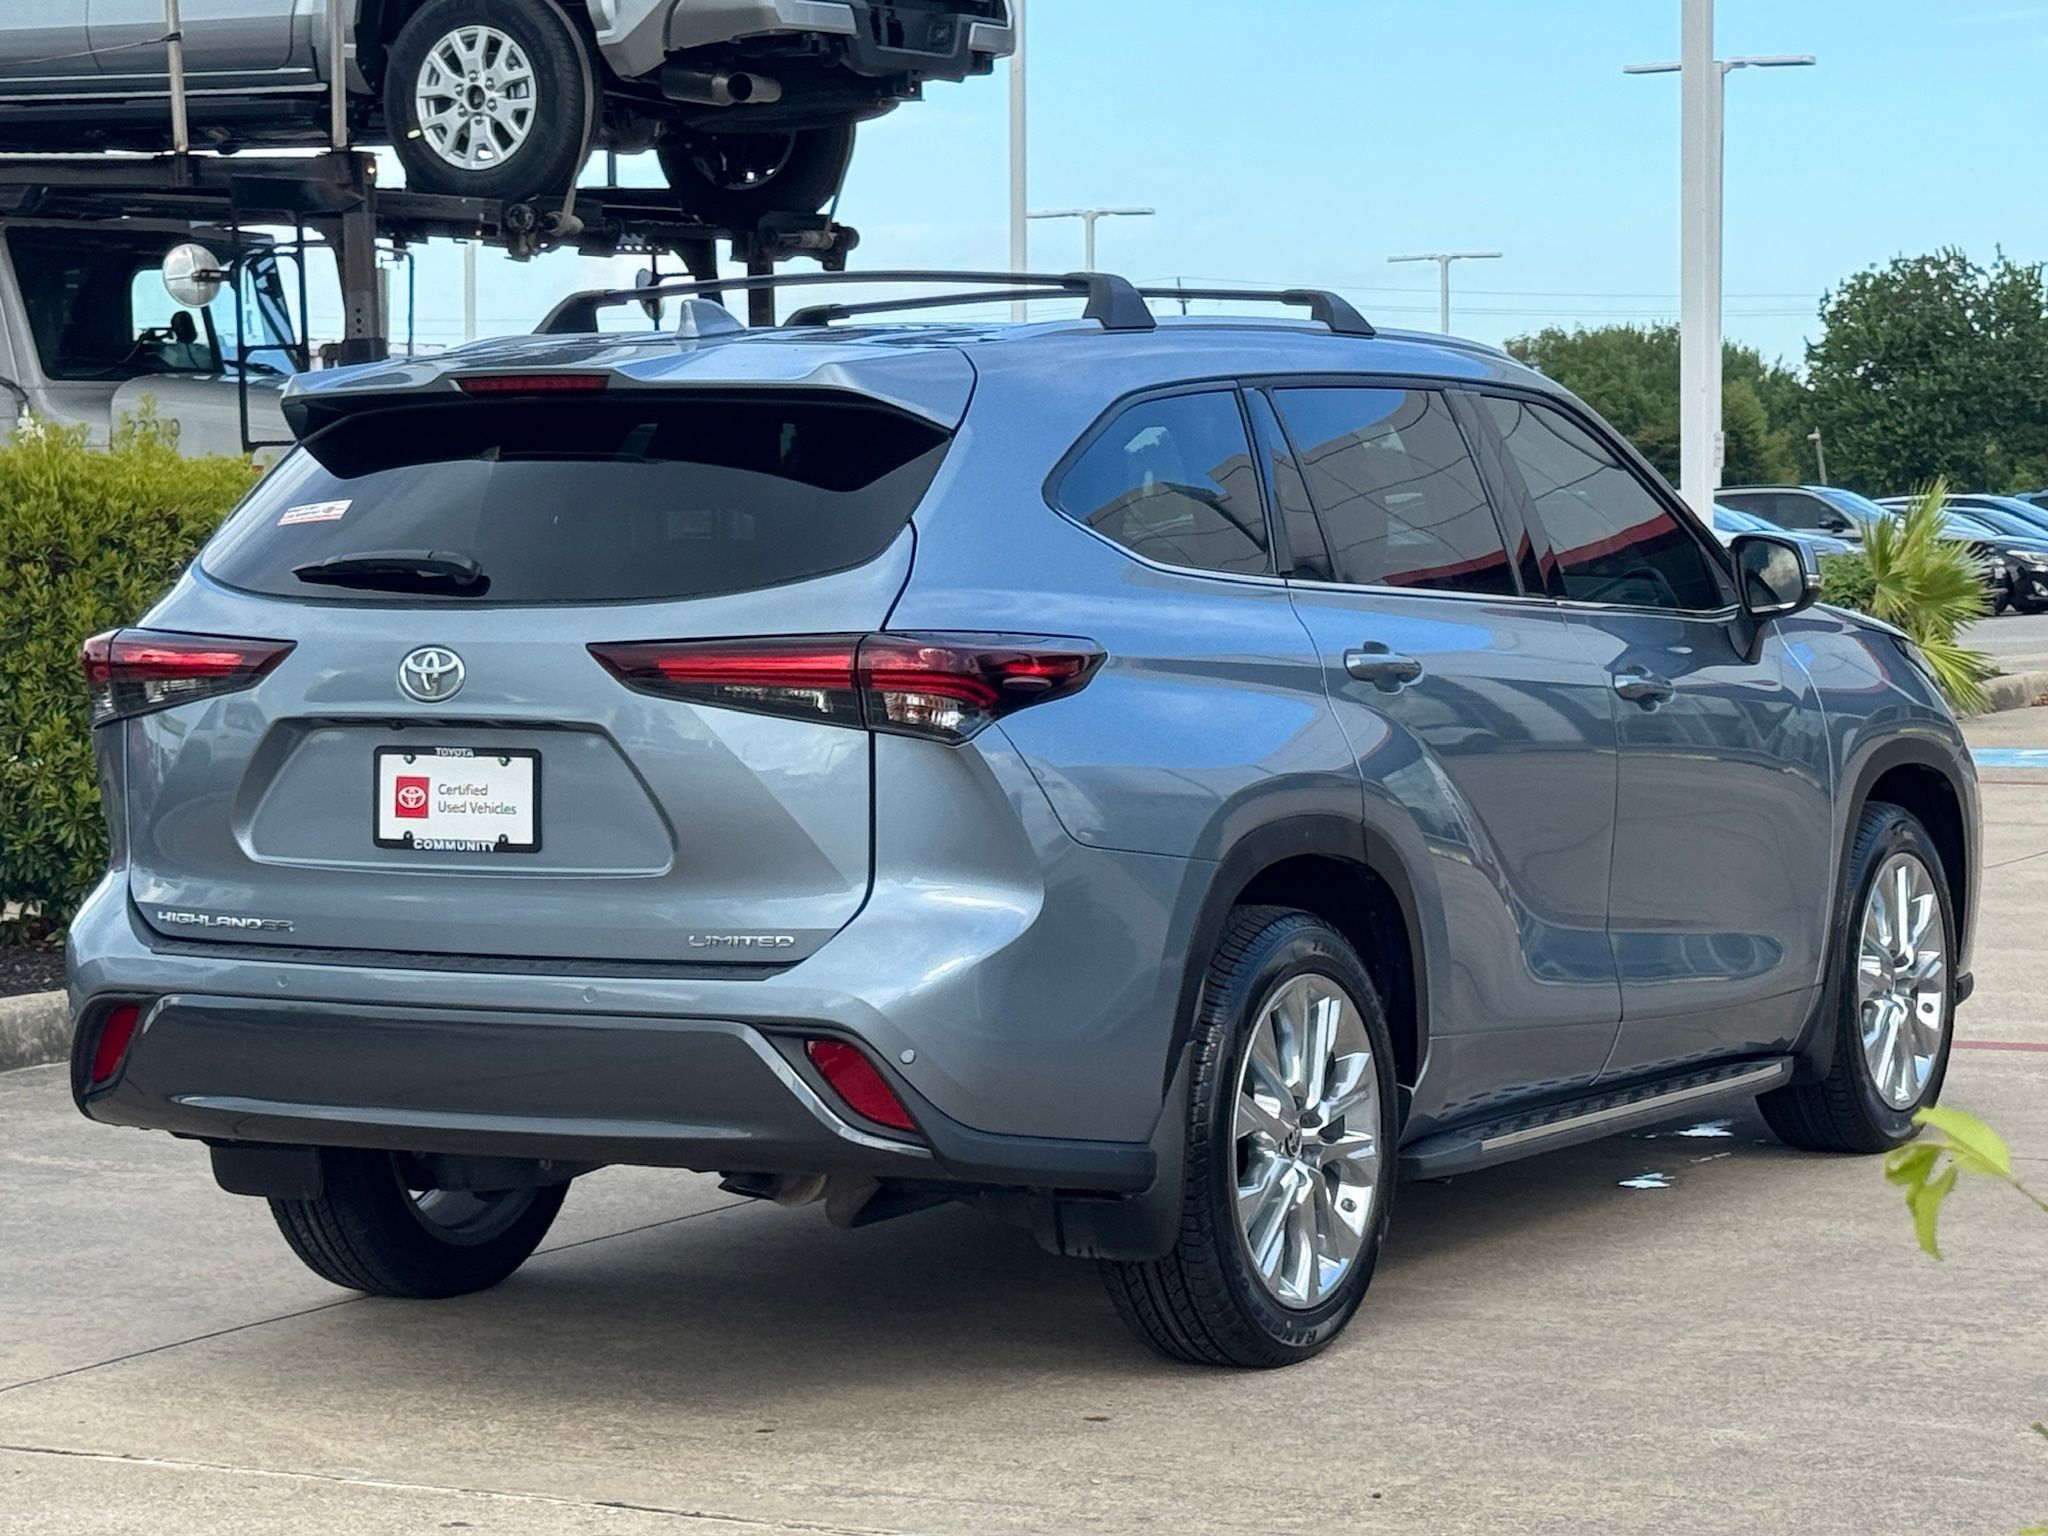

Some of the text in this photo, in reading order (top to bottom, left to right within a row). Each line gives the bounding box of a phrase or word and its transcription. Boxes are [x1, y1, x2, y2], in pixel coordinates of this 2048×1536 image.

[435, 747, 475, 757] TOYOTA
[438, 783, 489, 796] Certified
[438, 801, 517, 815] Used Vehicles
[413, 838, 497, 852] COMMUNITY
[157, 910, 296, 933] HIGHLANDER
[688, 935, 796, 947] LIMITED
